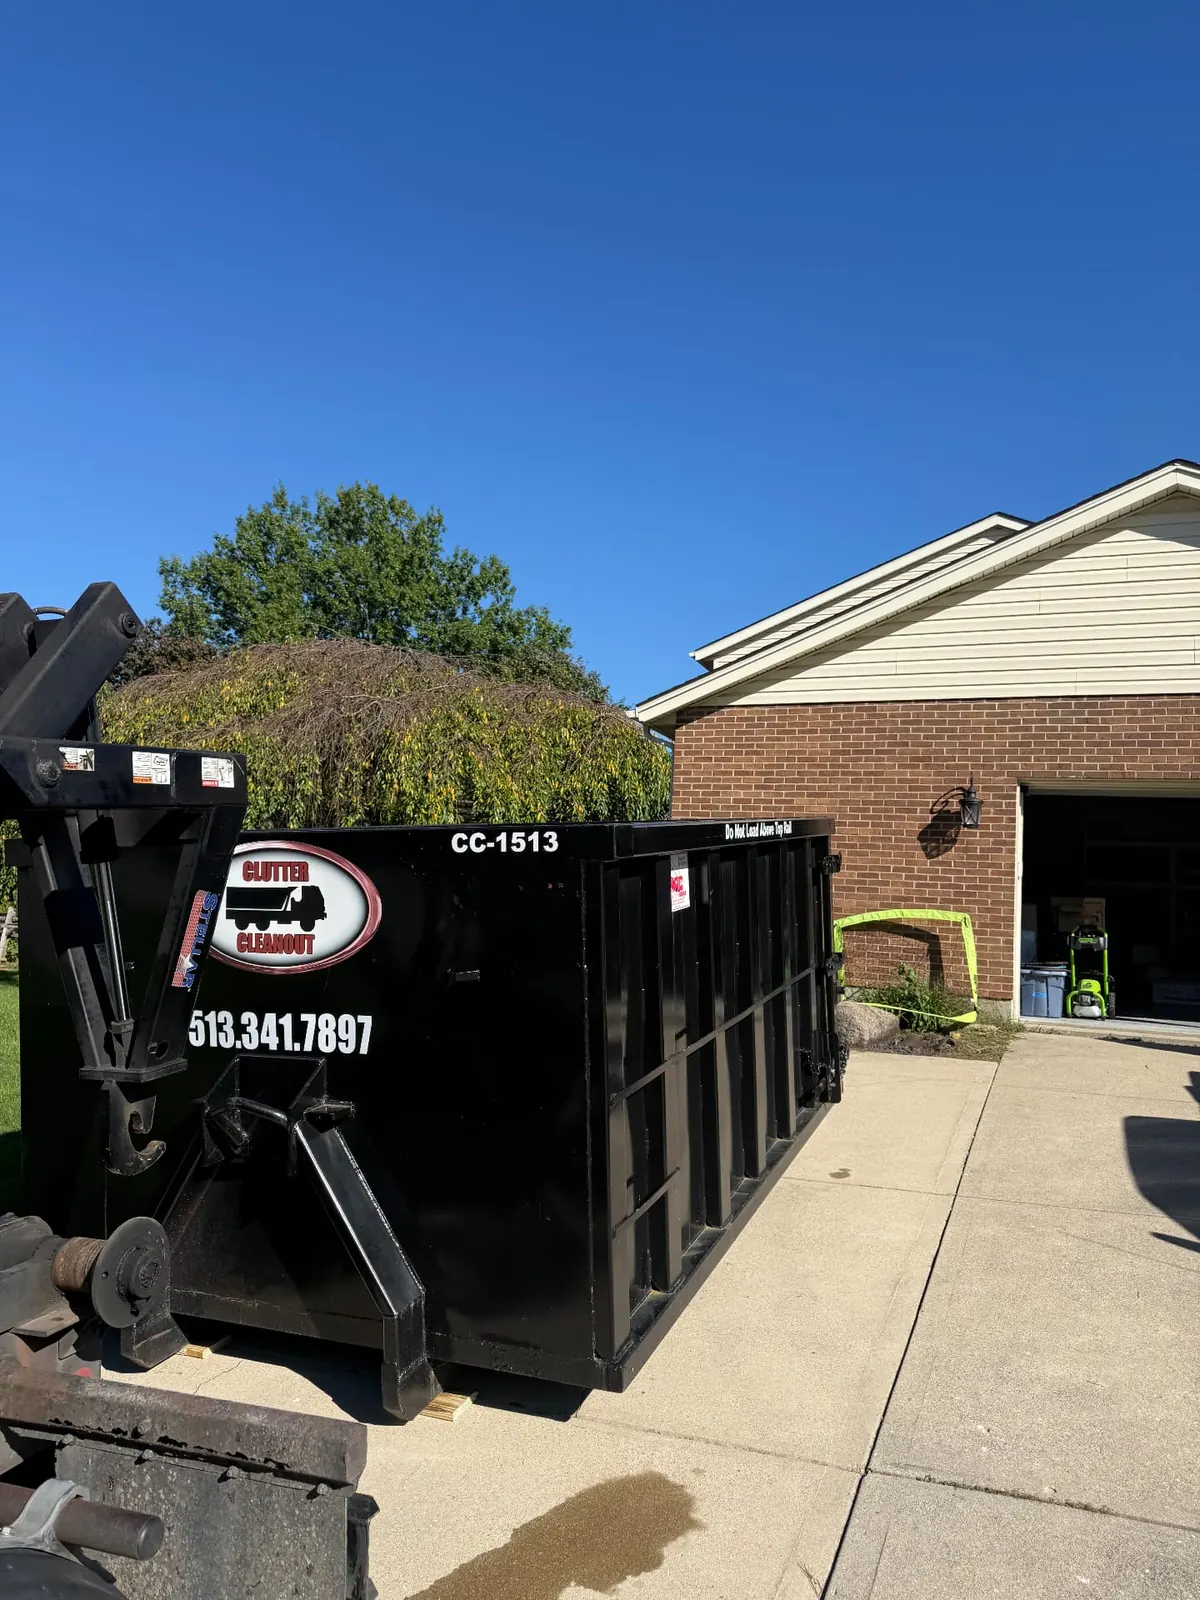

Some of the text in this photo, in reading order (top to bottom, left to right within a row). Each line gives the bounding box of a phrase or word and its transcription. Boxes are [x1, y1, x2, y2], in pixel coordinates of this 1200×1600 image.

[725, 820, 793, 840] Do Not Load Above Top Rail
[451, 831, 559, 853] CC-1513
[242, 860, 309, 882] CLUTTER
[181, 891, 218, 988] STELLAR
[236, 932, 316, 955] CLEANOUT
[188, 1010, 373, 1055] 513.341.7897
